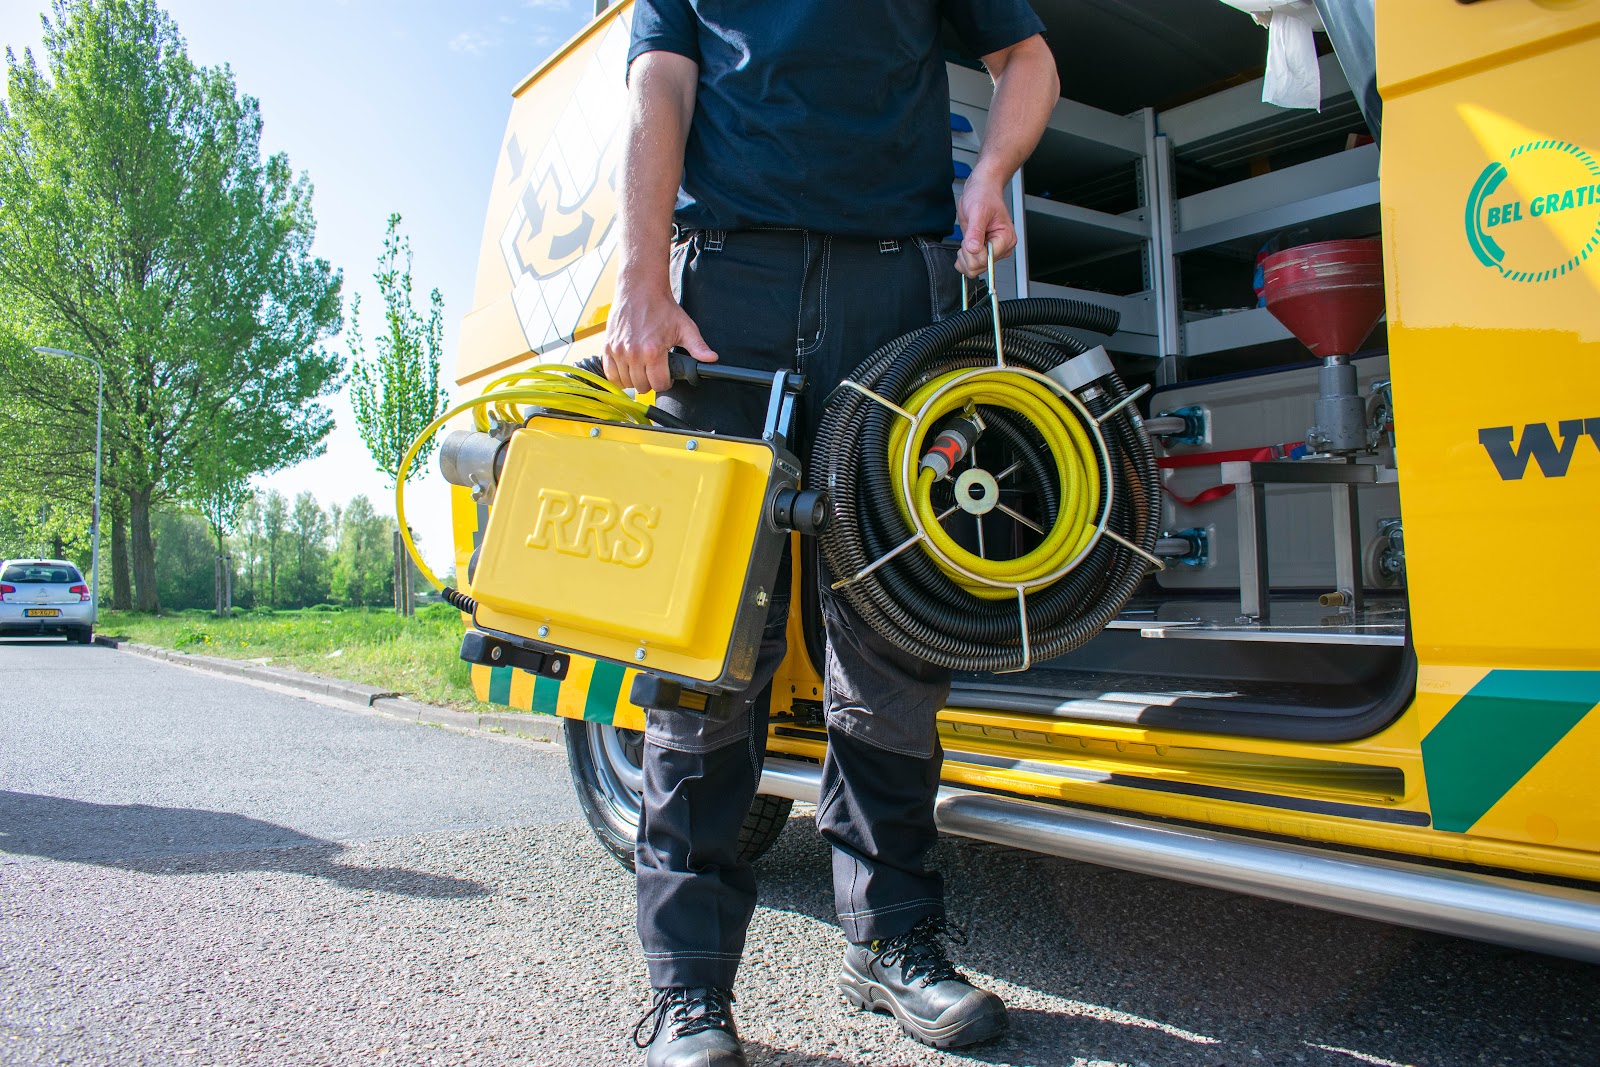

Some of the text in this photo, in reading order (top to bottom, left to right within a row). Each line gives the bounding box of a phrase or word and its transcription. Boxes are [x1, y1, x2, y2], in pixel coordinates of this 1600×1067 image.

[1487, 184, 1600, 228] BEL GRATIS
[525, 488, 661, 570] RRS
